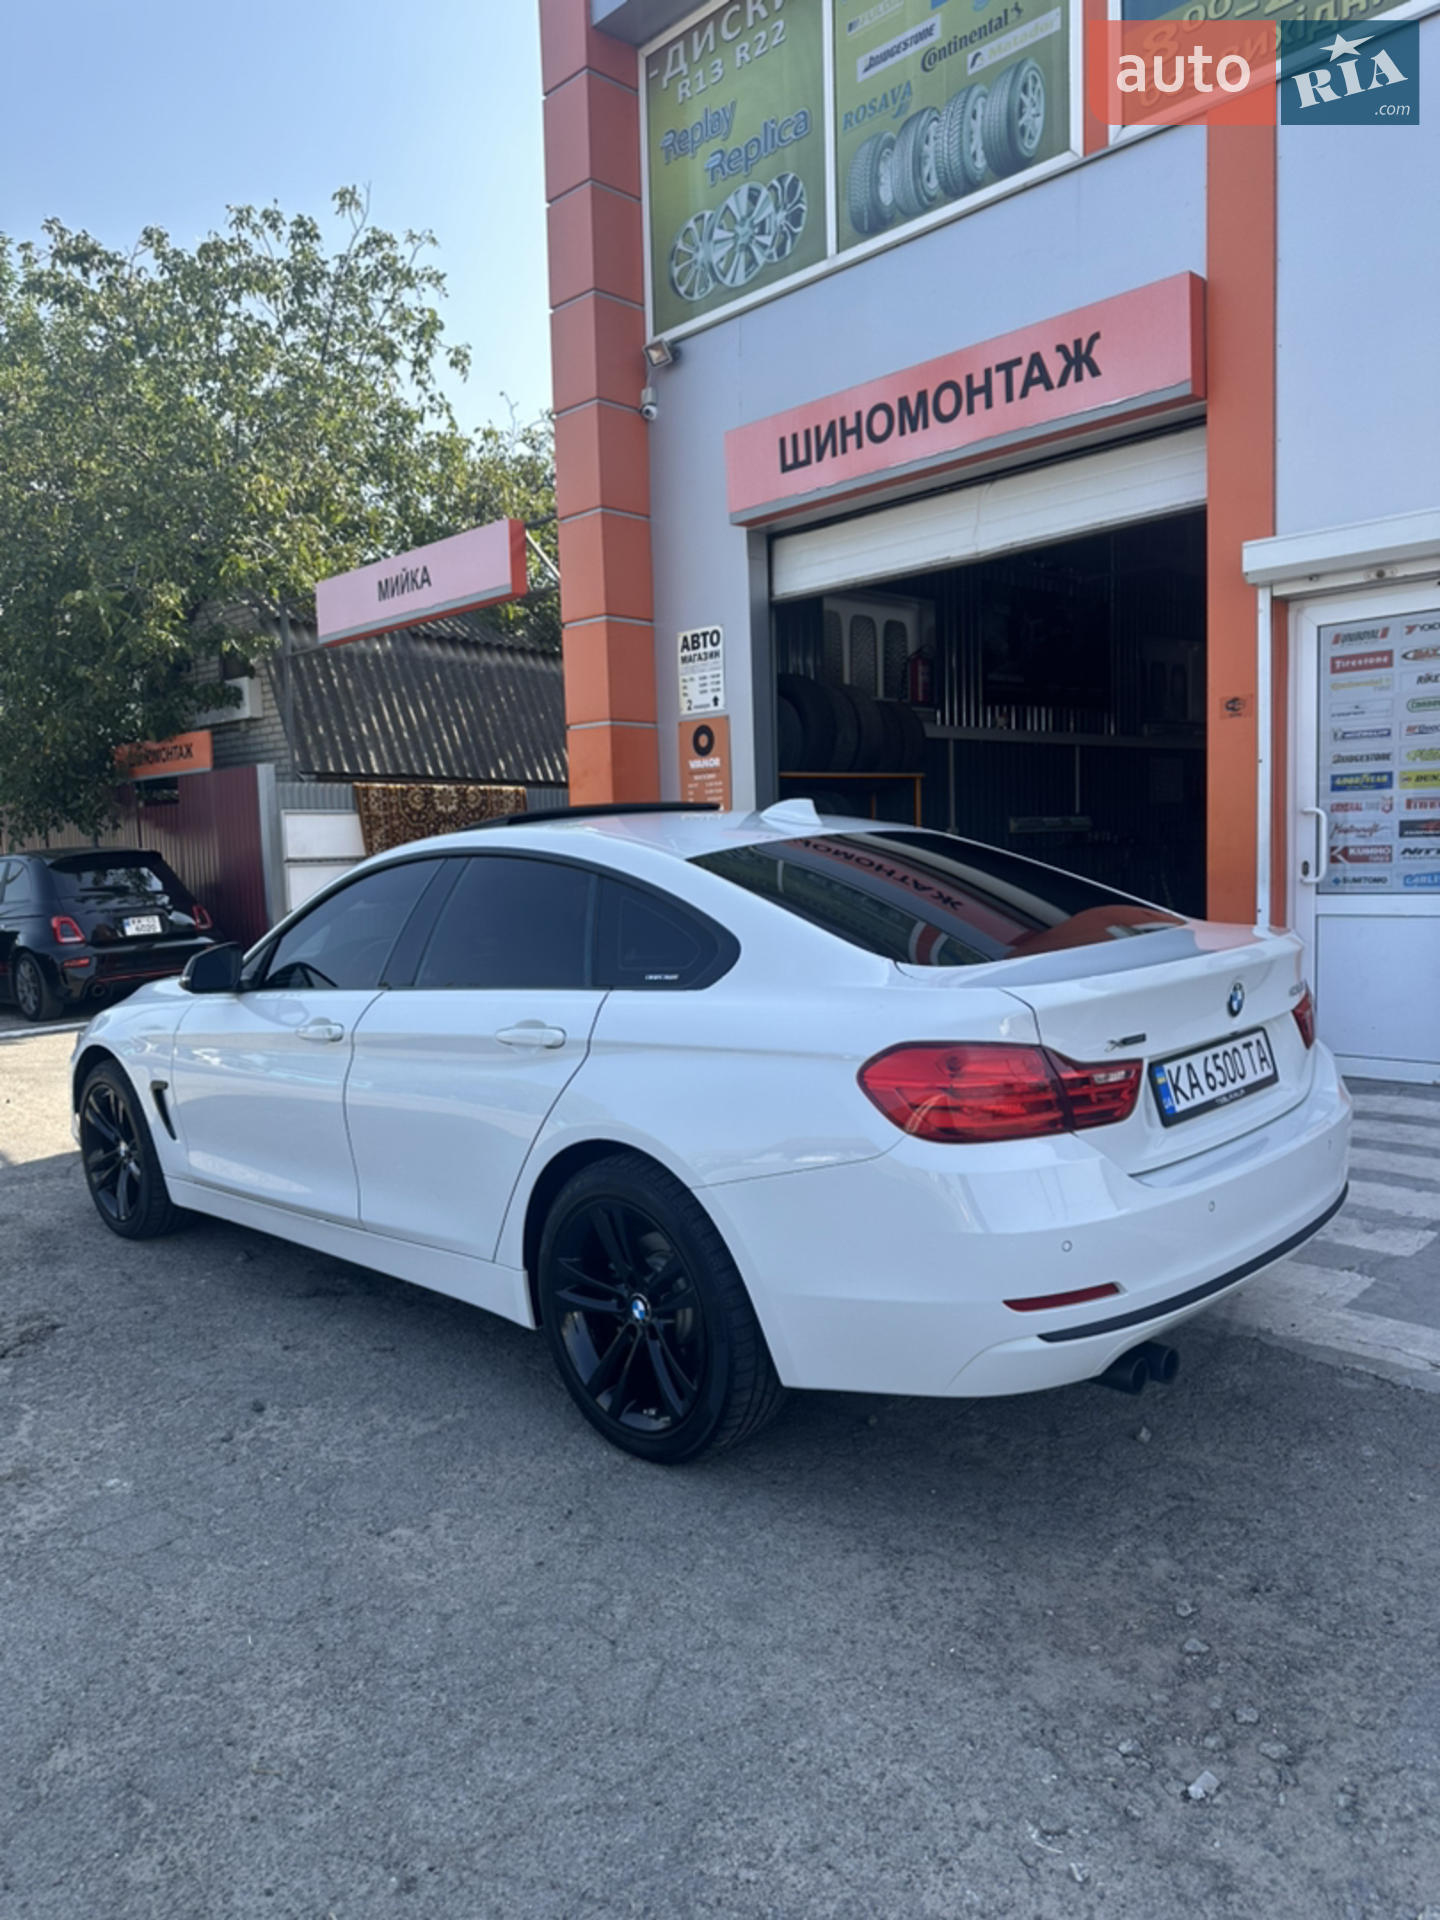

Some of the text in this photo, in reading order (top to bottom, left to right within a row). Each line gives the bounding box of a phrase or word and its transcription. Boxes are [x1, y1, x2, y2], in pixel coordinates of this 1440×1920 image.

[677, 19, 787, 104] R13 R22
[921, 8, 1009, 74] Continental
[660, 98, 737, 165] Replay
[842, 80, 914, 132] ROSAVA
[705, 107, 812, 187] Replica
[778, 331, 1102, 474] ШИНОМОНТАЖ
[378, 566, 432, 602] МИЙКА
[680, 629, 721, 653] АВТО
[680, 649, 720, 666] МАГАЗИН
[1166, 1038, 1272, 1105] KA 6500 TA
